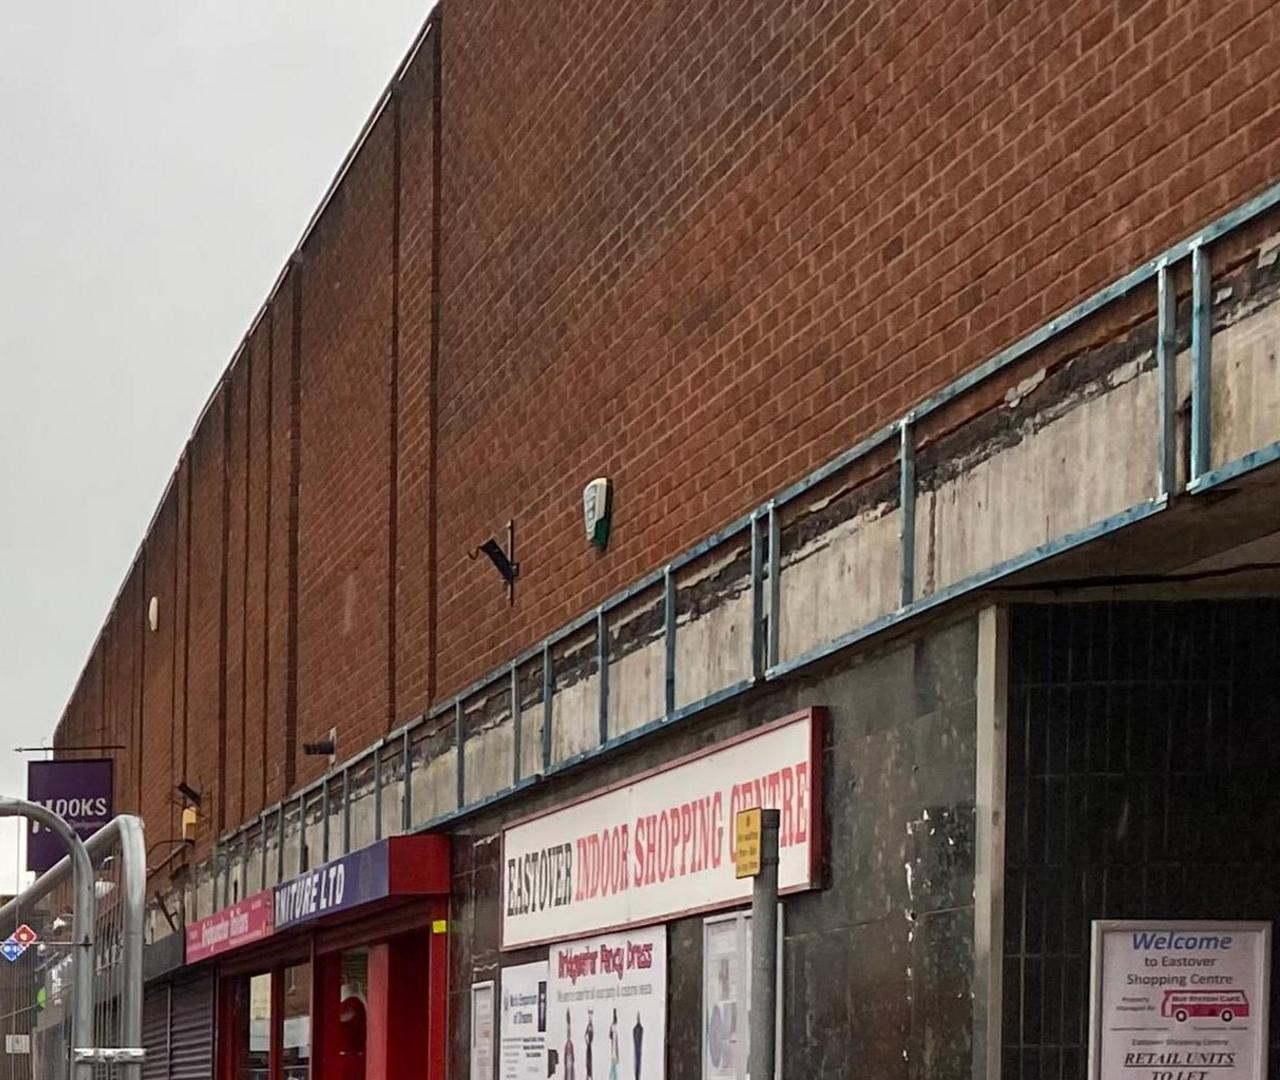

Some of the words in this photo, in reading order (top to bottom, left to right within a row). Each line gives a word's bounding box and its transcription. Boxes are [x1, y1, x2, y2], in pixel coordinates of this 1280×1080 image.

[506, 842, 572, 916] EASTOVER
[574, 823, 629, 902] INDOOR
[633, 791, 724, 888] SHOPPING
[320, 863, 345, 909] LTD
[1132, 932, 1233, 950] Welcome
[1145, 957, 1158, 967] to
[1161, 956, 1216, 967] Eastover
[1127, 973, 1187, 987] Shopping
[1190, 973, 1233, 985] Centre
[1124, 1052, 1182, 1066] RETAIL
[1186, 1052, 1236, 1066] UNITS
